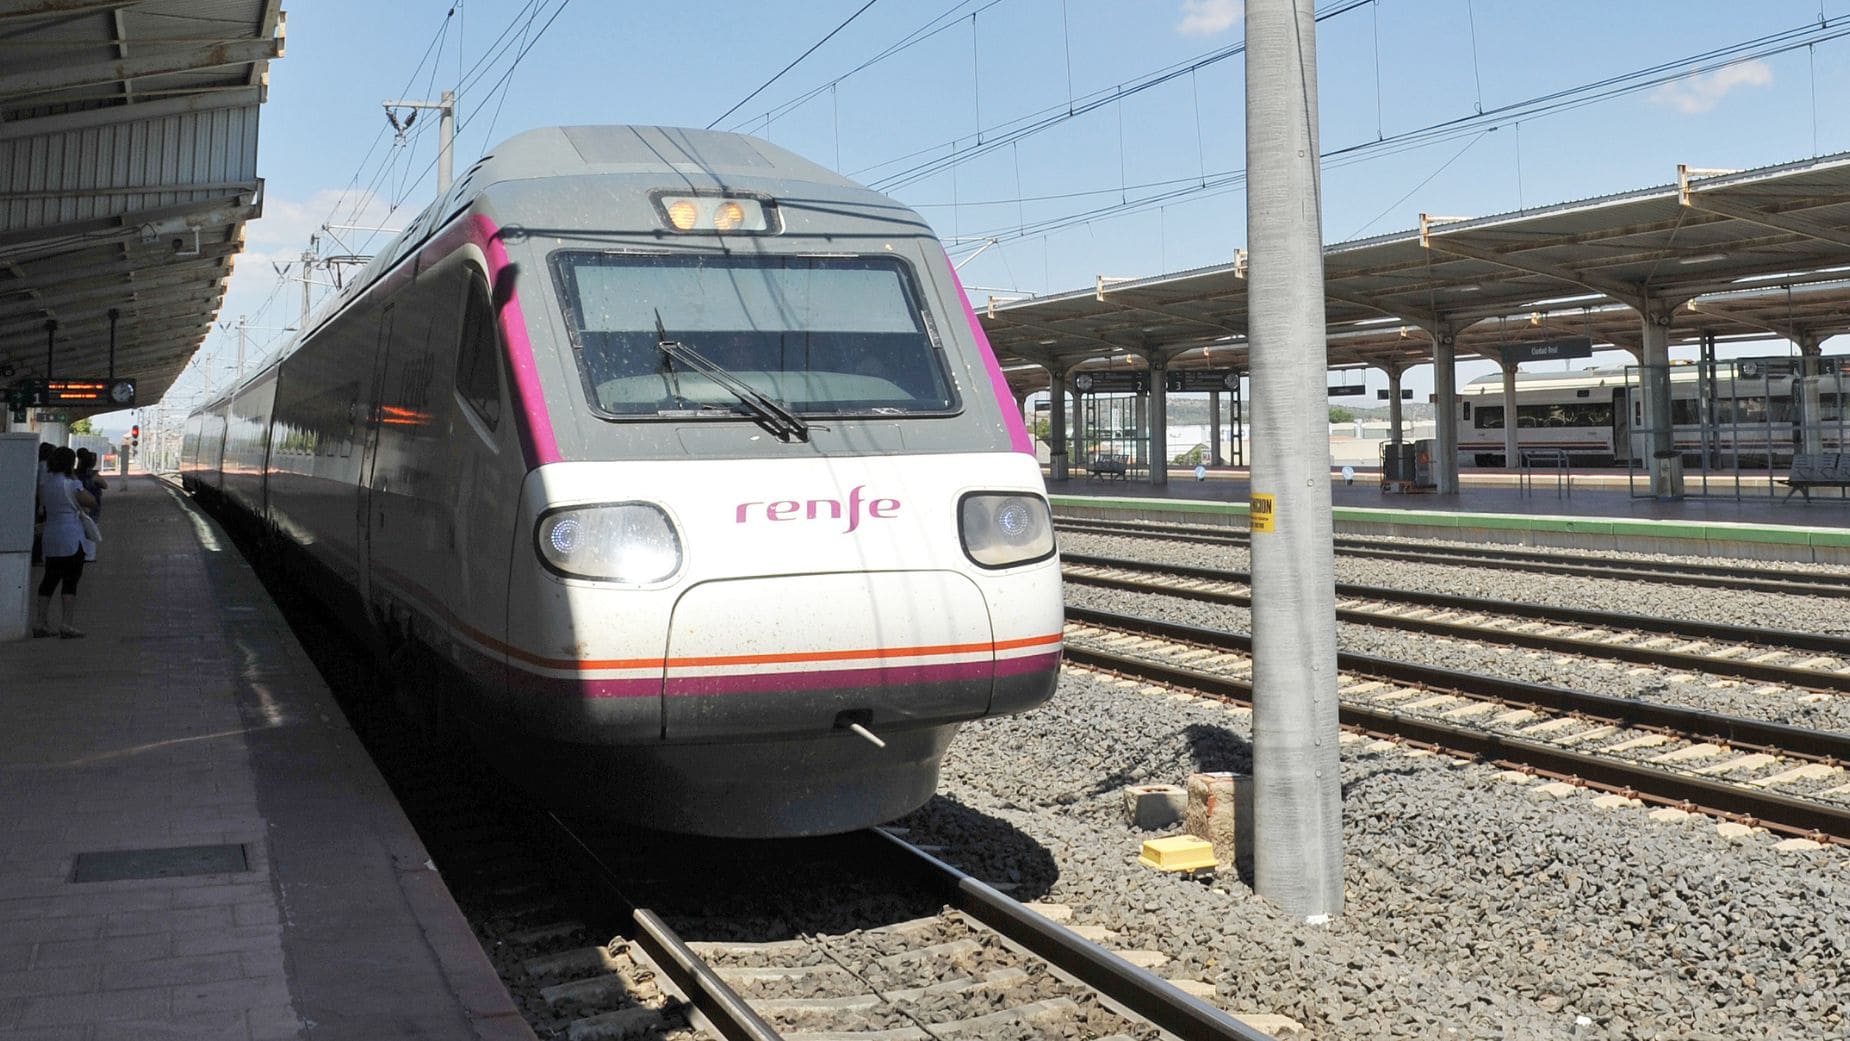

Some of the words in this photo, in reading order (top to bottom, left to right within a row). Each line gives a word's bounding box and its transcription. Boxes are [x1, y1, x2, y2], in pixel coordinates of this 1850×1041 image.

[1136, 381, 1142, 391] 2
[1175, 381, 1182, 391] 3
[33, 392, 42, 405] 1
[736, 485, 901, 534] renfe
